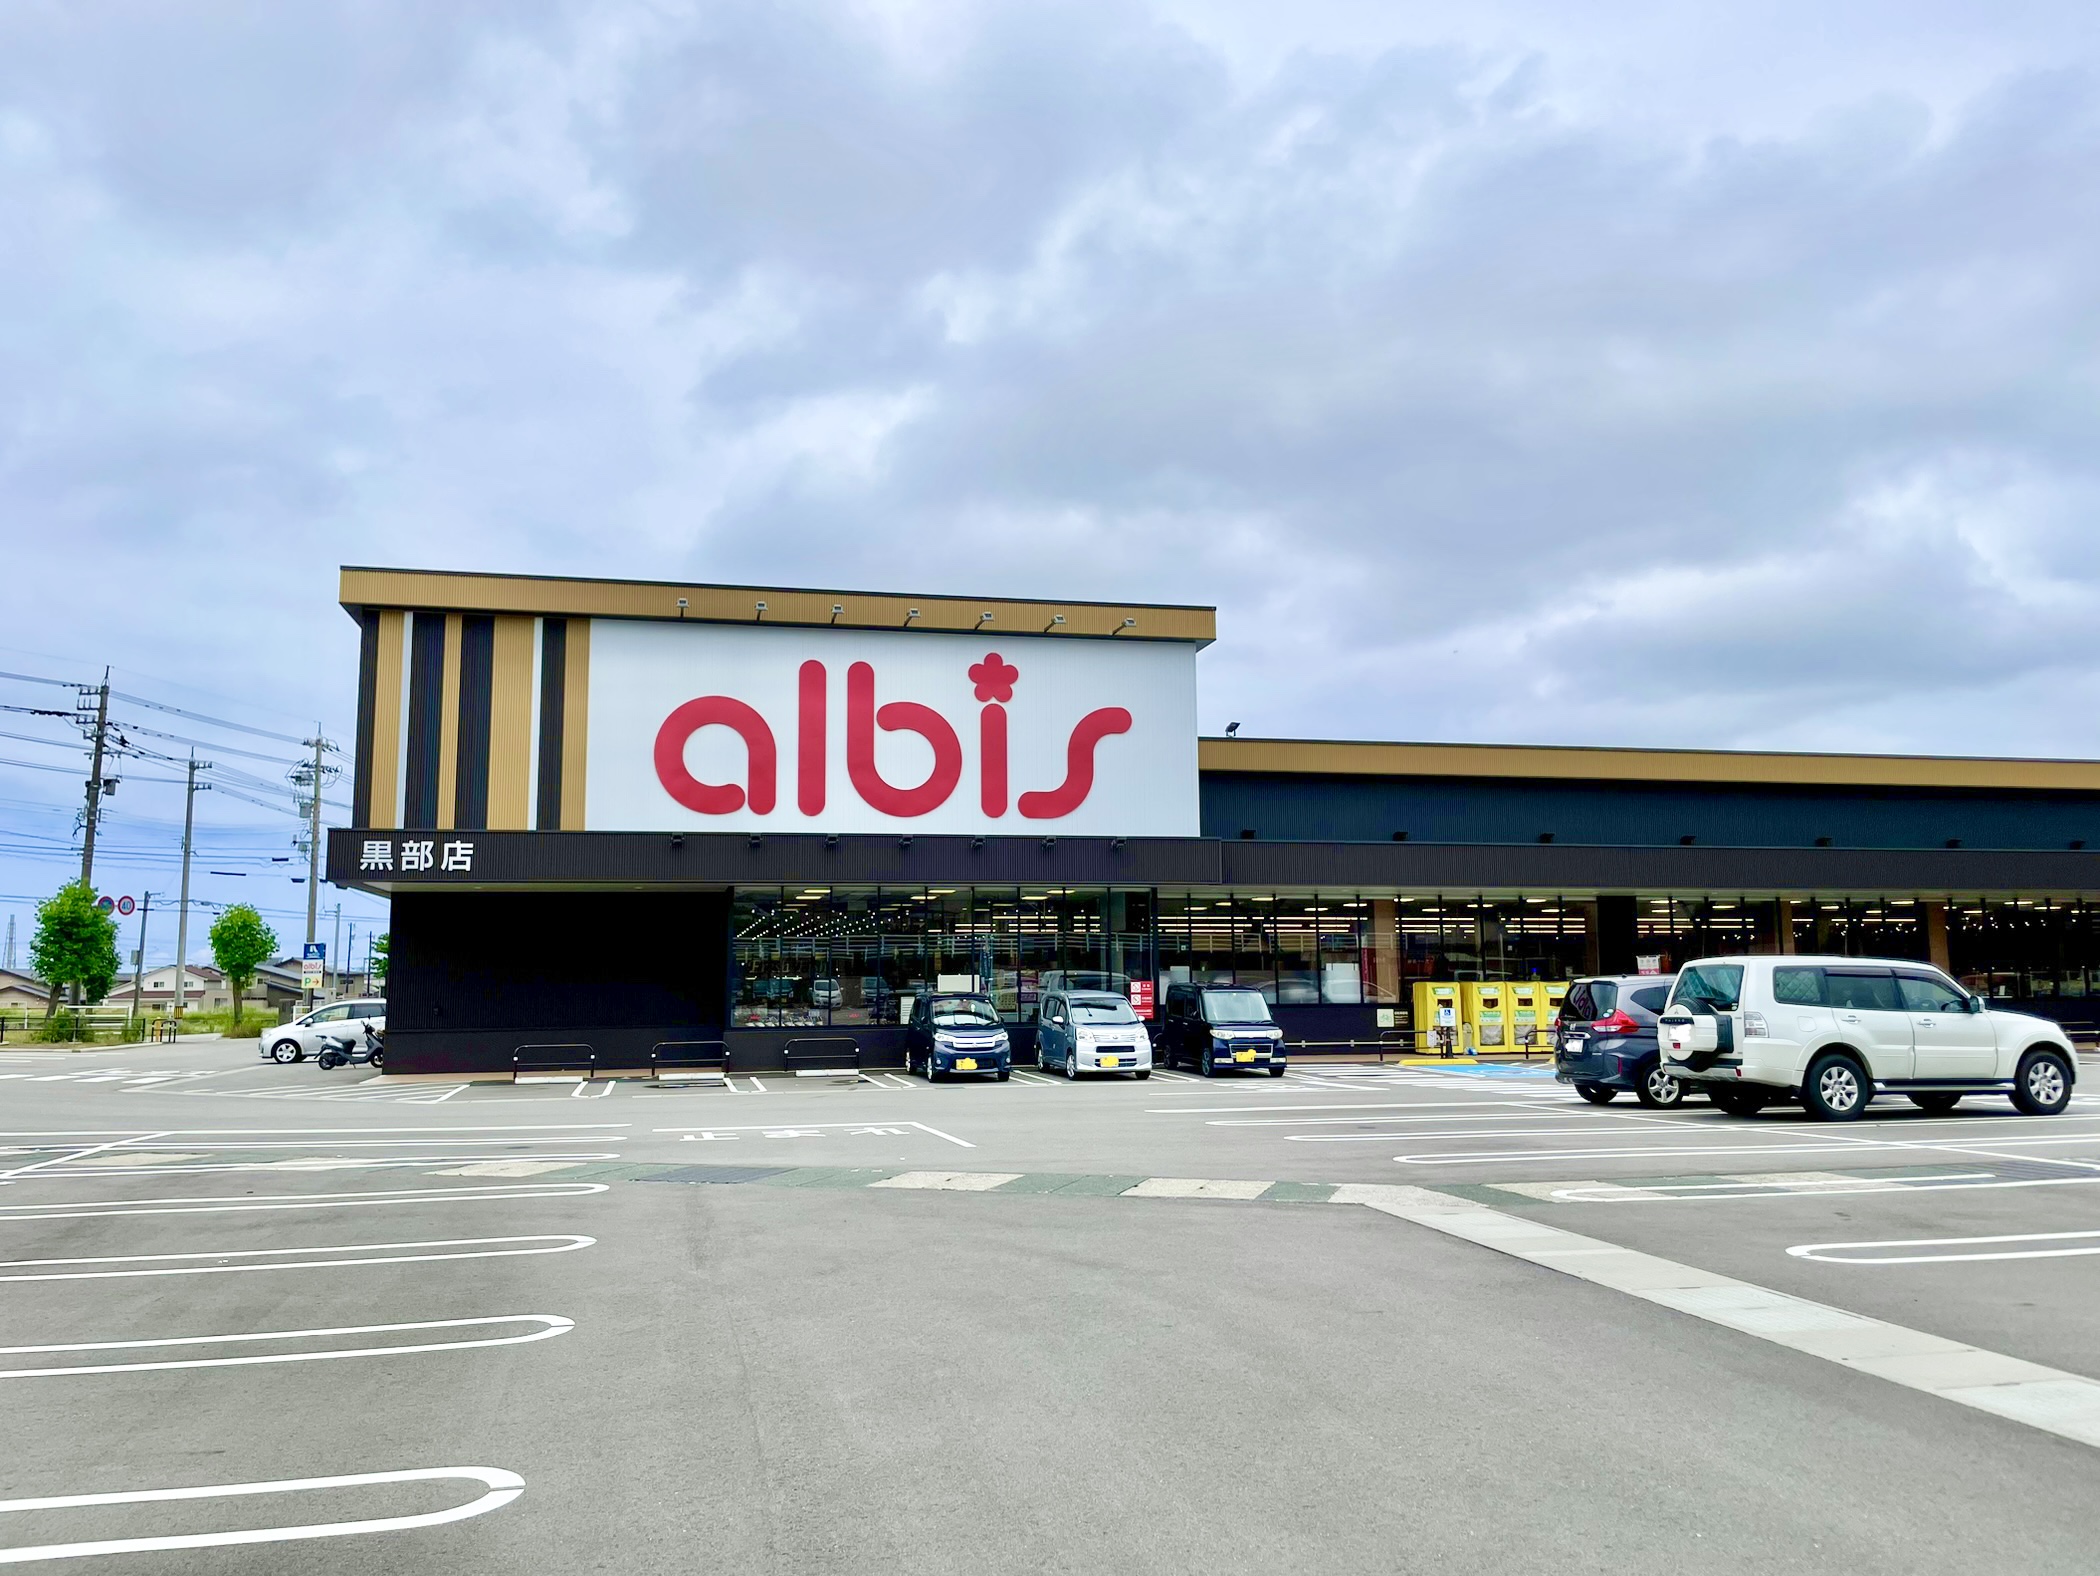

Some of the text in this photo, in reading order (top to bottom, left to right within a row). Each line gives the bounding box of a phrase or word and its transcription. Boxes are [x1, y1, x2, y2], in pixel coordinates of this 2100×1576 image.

[654, 652, 1132, 818] albis
[359, 840, 475, 872] 黒部店
[121, 900, 132, 911] 40
[304, 977, 311, 987] P
[679, 1127, 910, 1142] 止まれ
